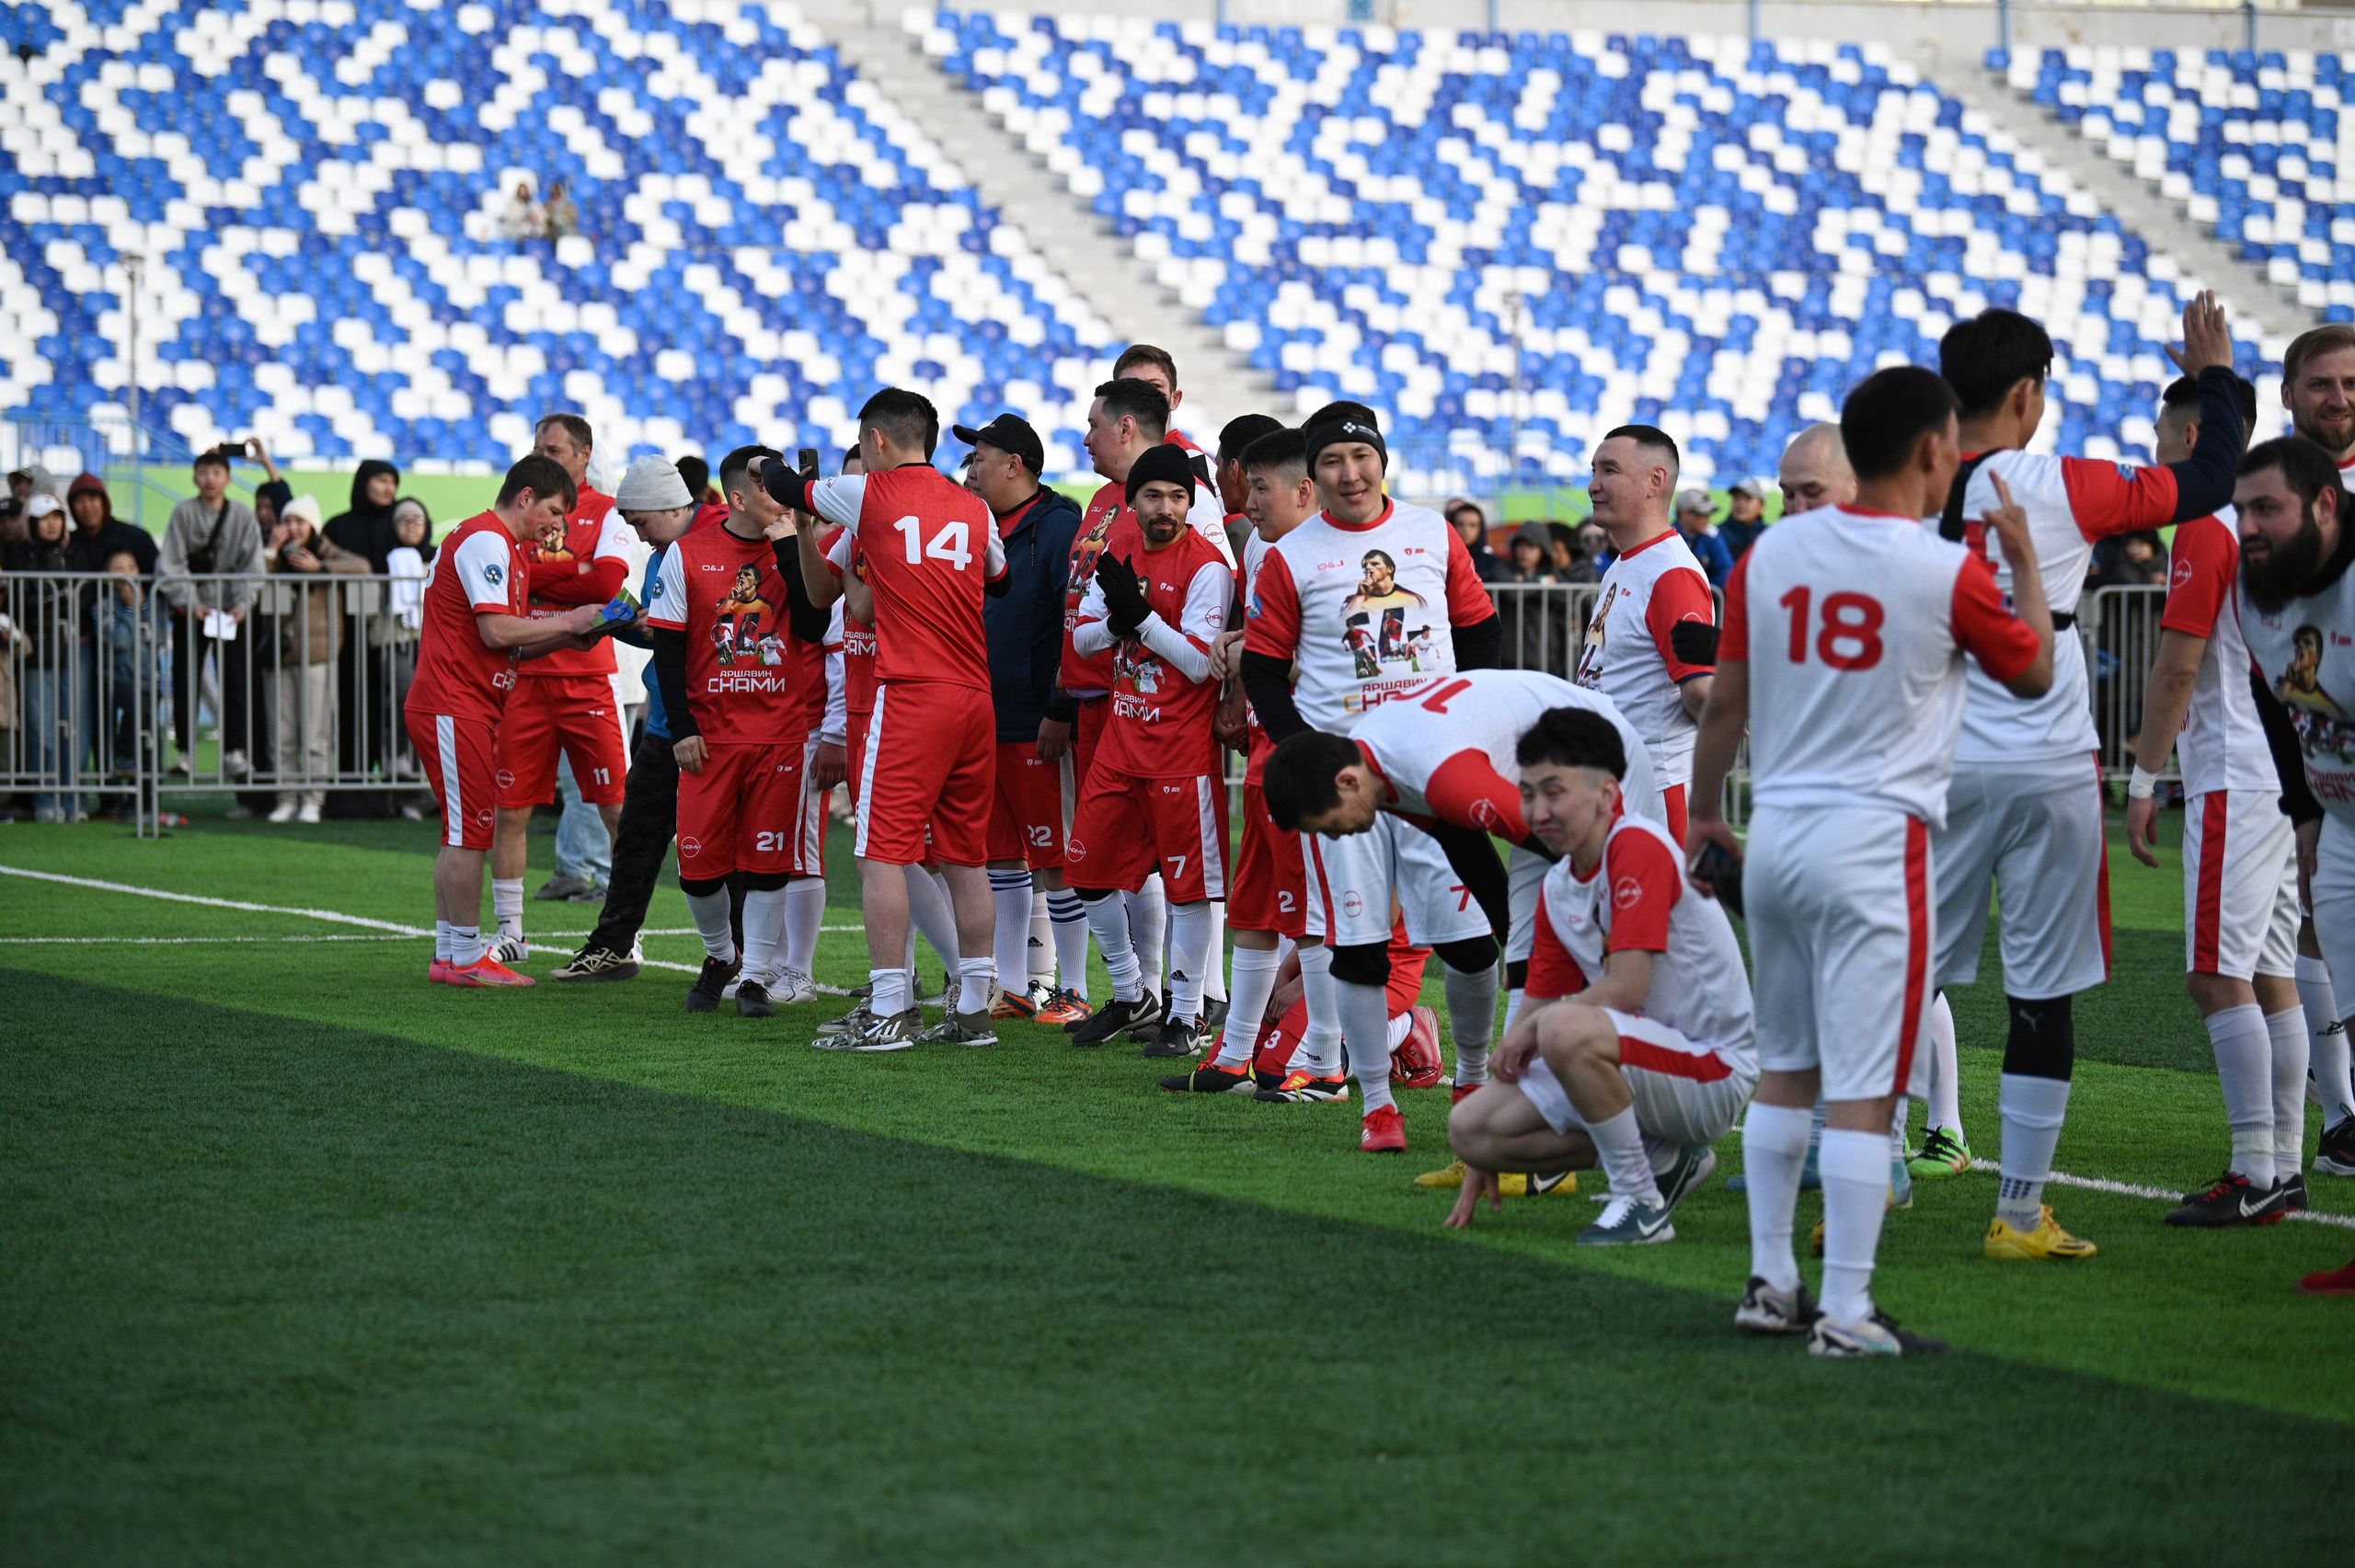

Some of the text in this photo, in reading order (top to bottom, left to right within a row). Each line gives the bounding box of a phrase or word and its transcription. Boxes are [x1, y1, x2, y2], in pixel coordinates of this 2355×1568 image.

[893, 515, 972, 571] 14
[1317, 559, 1344, 571] O&J
[1780, 585, 1885, 671] 18
[844, 640, 877, 657] НАМ
[719, 670, 772, 678] АРШАВИН
[707, 677, 786, 692] СНАМИ
[1113, 690, 1146, 705] РШАВИН
[593, 767, 611, 785] 11
[756, 830, 785, 852] 21
[1167, 855, 1187, 879] 7
[1278, 890, 1296, 913] 2
[1450, 885, 1471, 912] 7
[1264, 1029, 1281, 1049] 3
